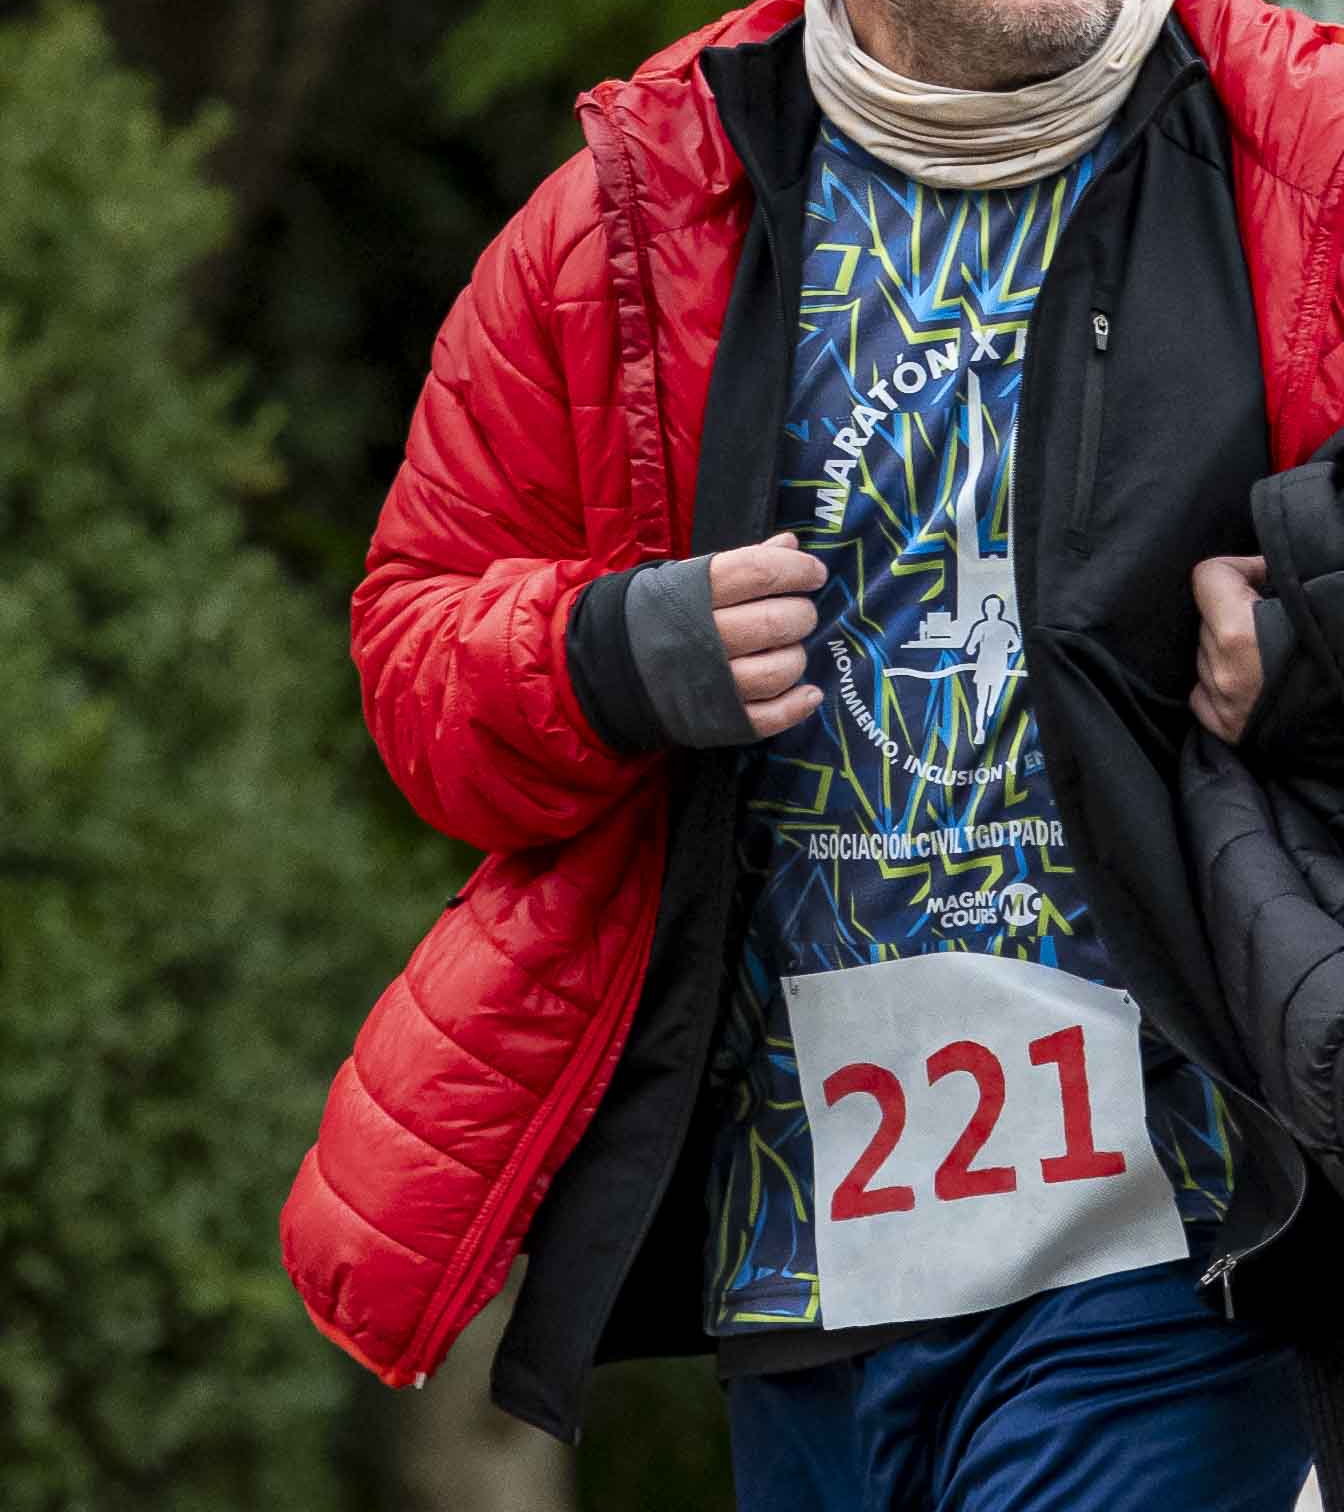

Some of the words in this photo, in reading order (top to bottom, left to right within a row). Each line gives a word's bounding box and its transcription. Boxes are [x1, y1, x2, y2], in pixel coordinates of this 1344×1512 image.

[815, 341, 960, 526] MARATÓN
[970, 328, 1000, 362] X
[902, 754, 1003, 786] INCLUSIÓN
[808, 824, 911, 860] ASOCIACIÓN
[917, 827, 962, 858] CIVIL
[964, 821, 1003, 849] TGD
[1008, 820, 1064, 848] PADR
[926, 890, 997, 914] MAGNY
[941, 908, 997, 929] COURS
[822, 1024, 1127, 1223] 221
